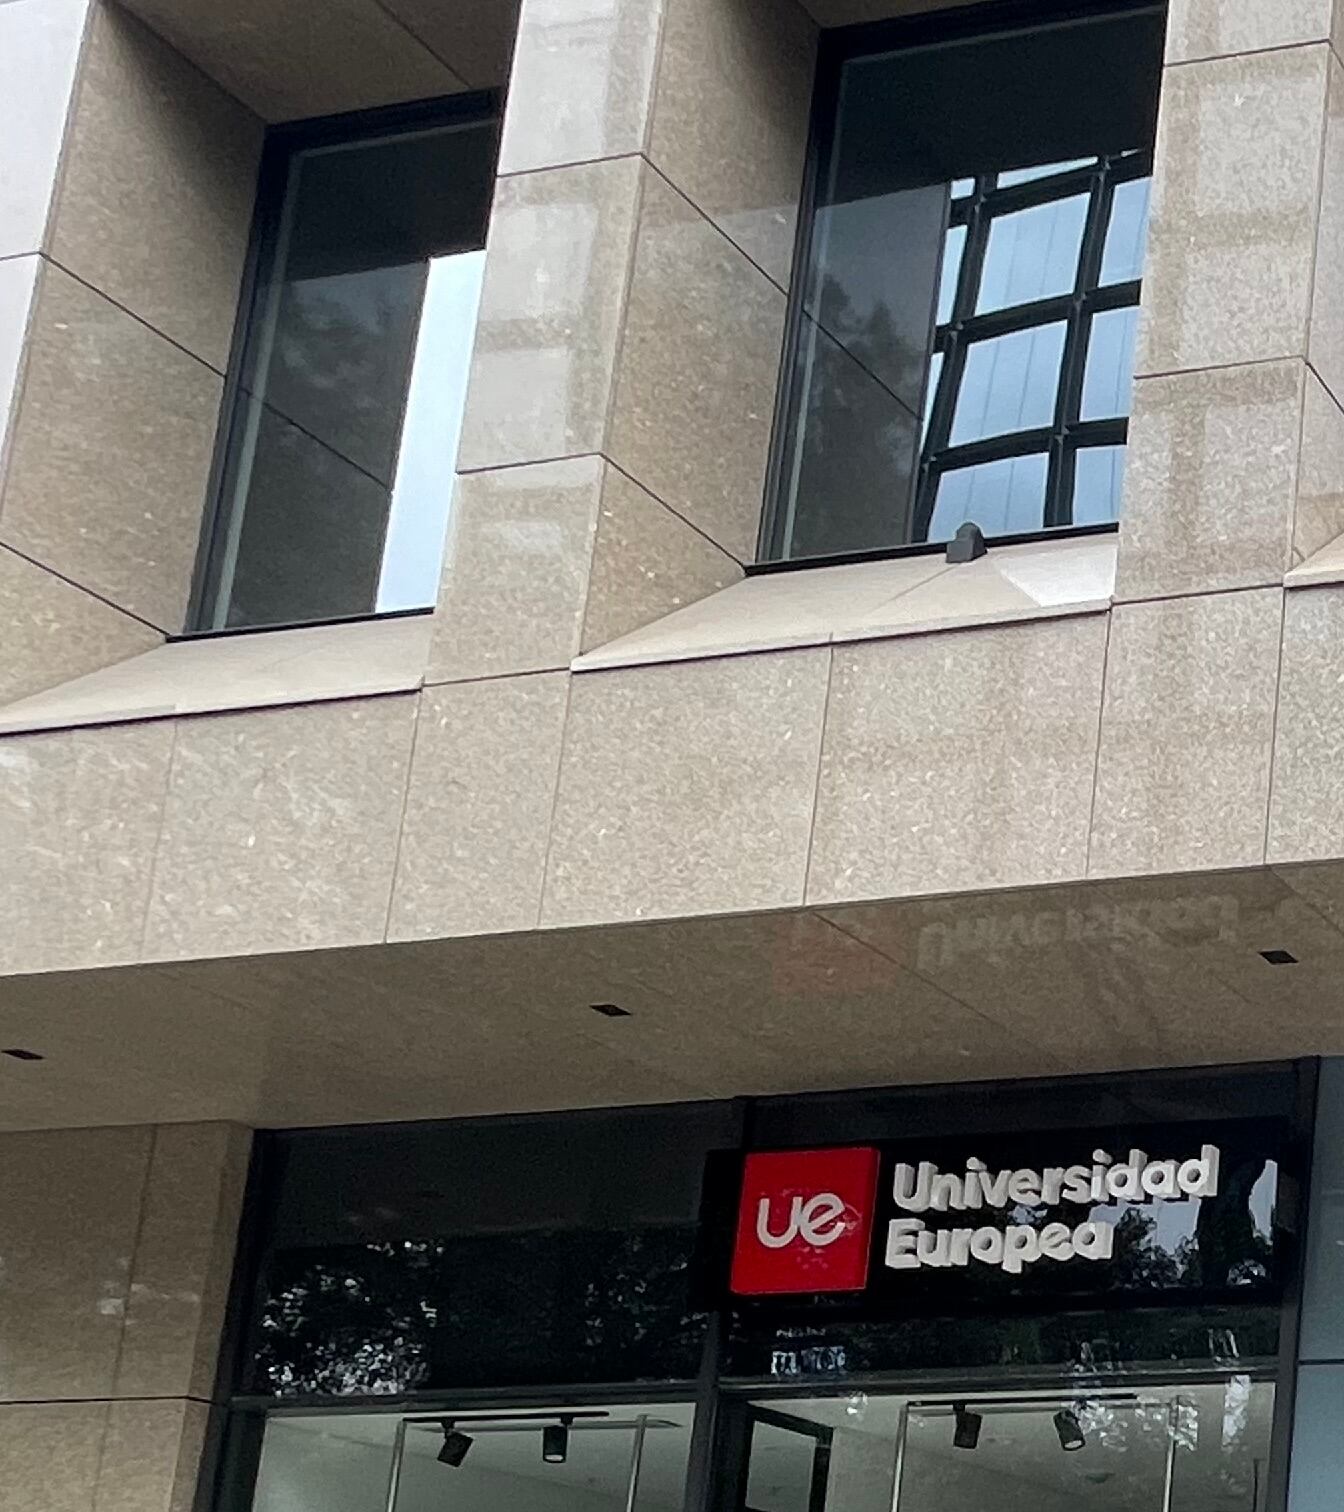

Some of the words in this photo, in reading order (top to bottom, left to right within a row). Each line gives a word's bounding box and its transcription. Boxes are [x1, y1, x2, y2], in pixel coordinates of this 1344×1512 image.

[892, 1144, 1220, 1212] Universidad
[755, 1192, 848, 1249] ue
[885, 1217, 1114, 1274] Europea
